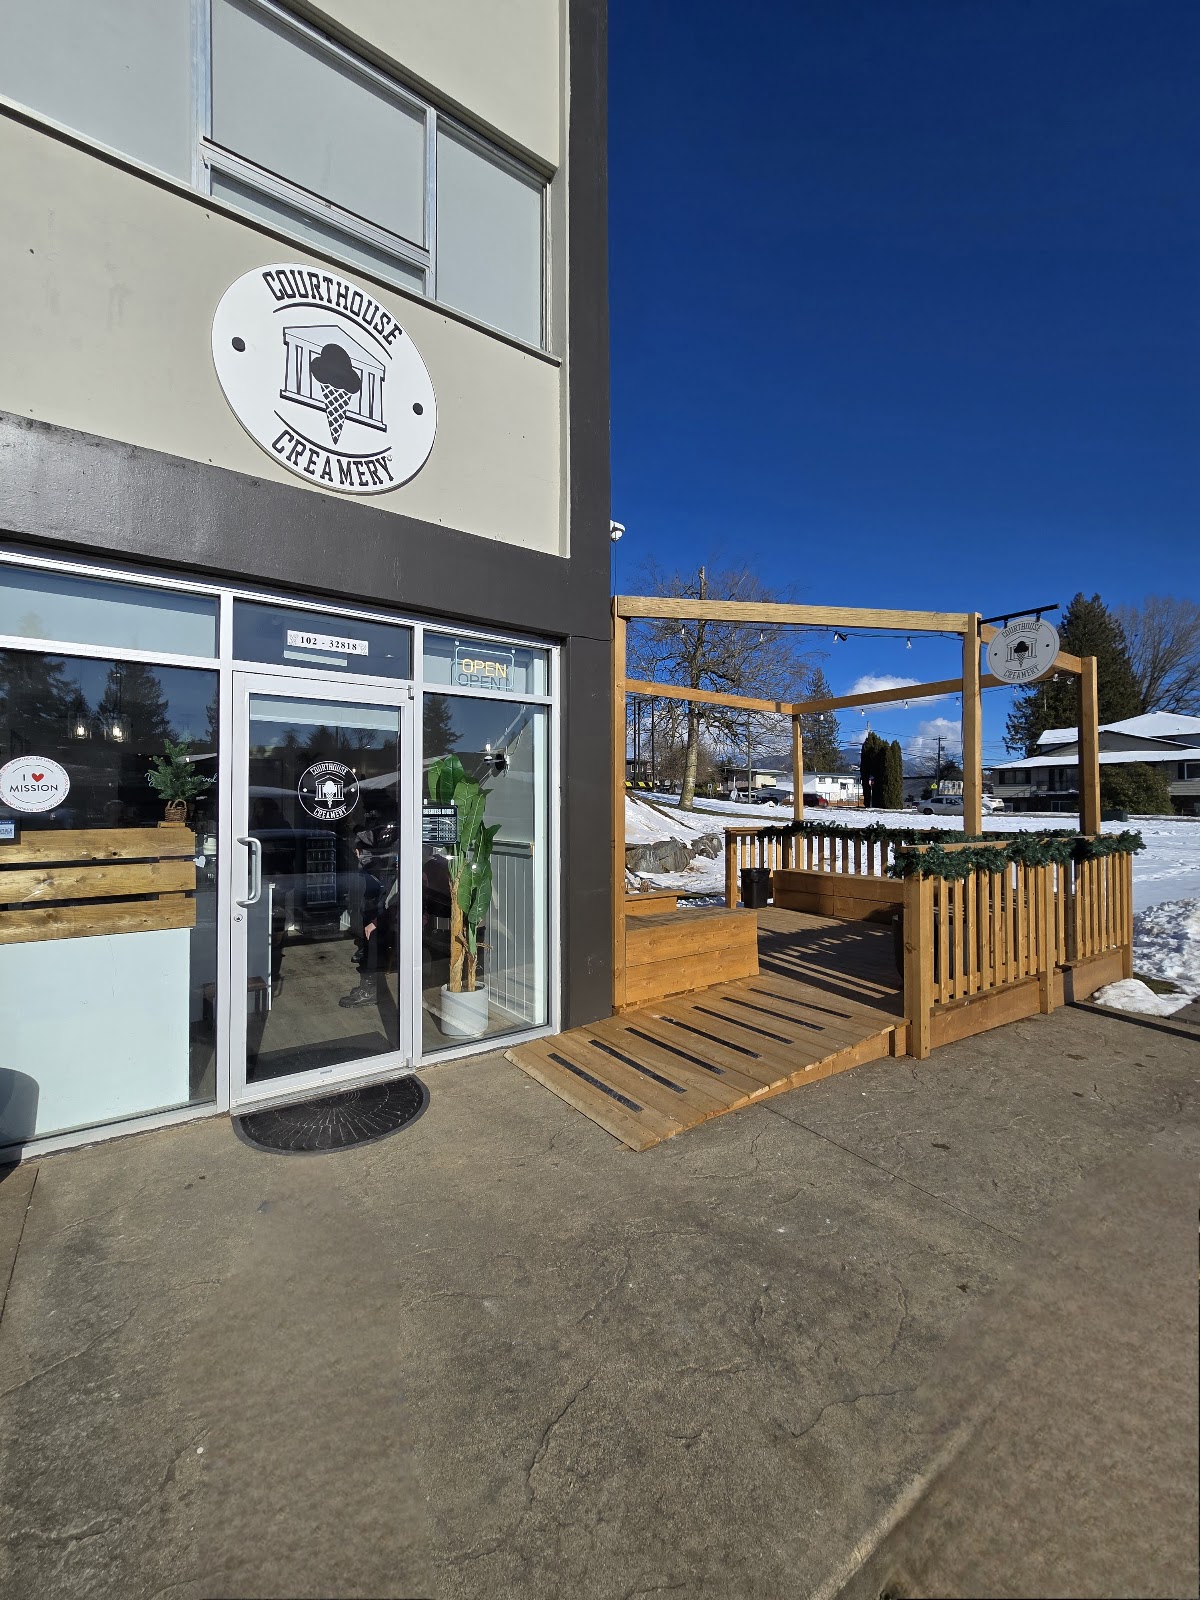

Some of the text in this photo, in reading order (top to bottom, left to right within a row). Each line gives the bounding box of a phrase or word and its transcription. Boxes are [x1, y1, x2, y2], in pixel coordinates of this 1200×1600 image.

[262, 269, 402, 345] COURTHOUSE
[271, 429, 394, 487] CREAMERY
[1002, 622, 1042, 638] COURTHOUSE
[300, 636, 317, 645] 102
[328, 640, 357, 651] 32818
[462, 658, 507, 678] OPEN
[1004, 665, 1040, 679] CREAMERY
[310, 763, 348, 775] COURTHOUSE
[314, 806, 347, 818] CREAMERY
